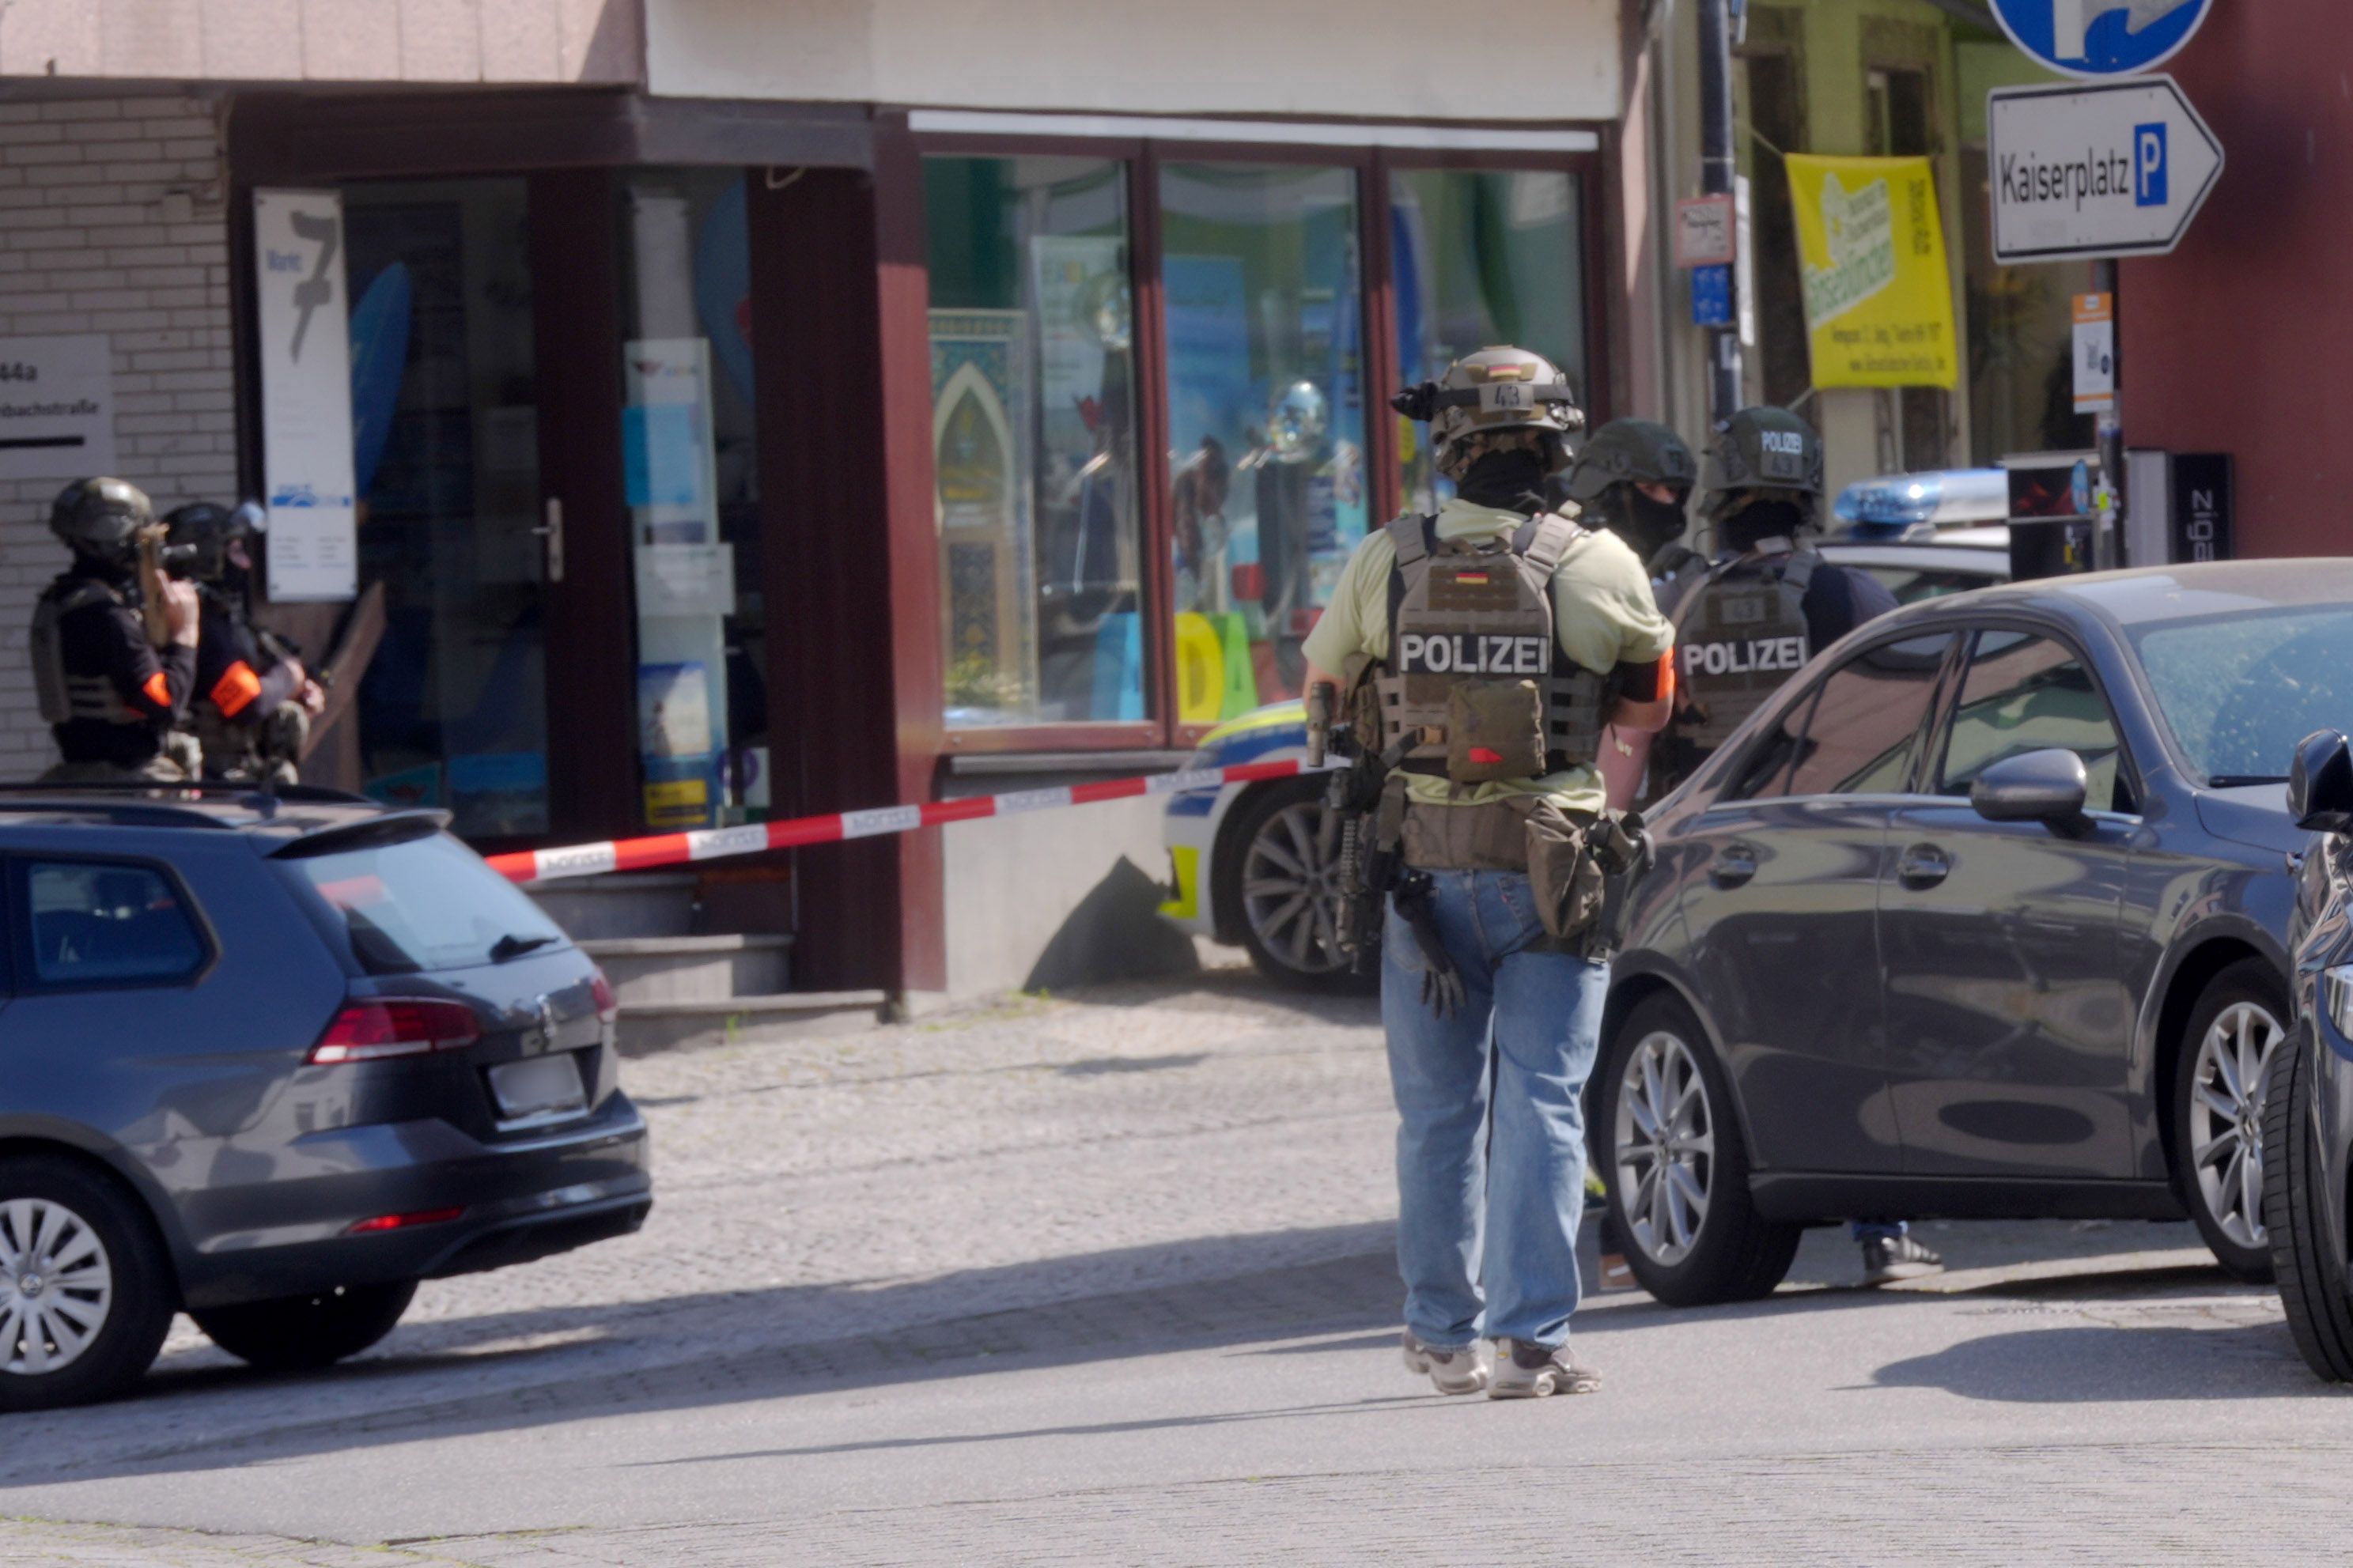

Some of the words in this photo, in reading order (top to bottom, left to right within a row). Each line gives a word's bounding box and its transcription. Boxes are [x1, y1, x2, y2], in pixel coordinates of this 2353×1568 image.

[2000, 147, 2128, 213] Kaiserplatz
[2139, 132, 2162, 197] P
[1494, 385, 1519, 406] 43
[1400, 634, 1549, 673] POLIZEI
[1682, 636, 1806, 676] POLIZEI
